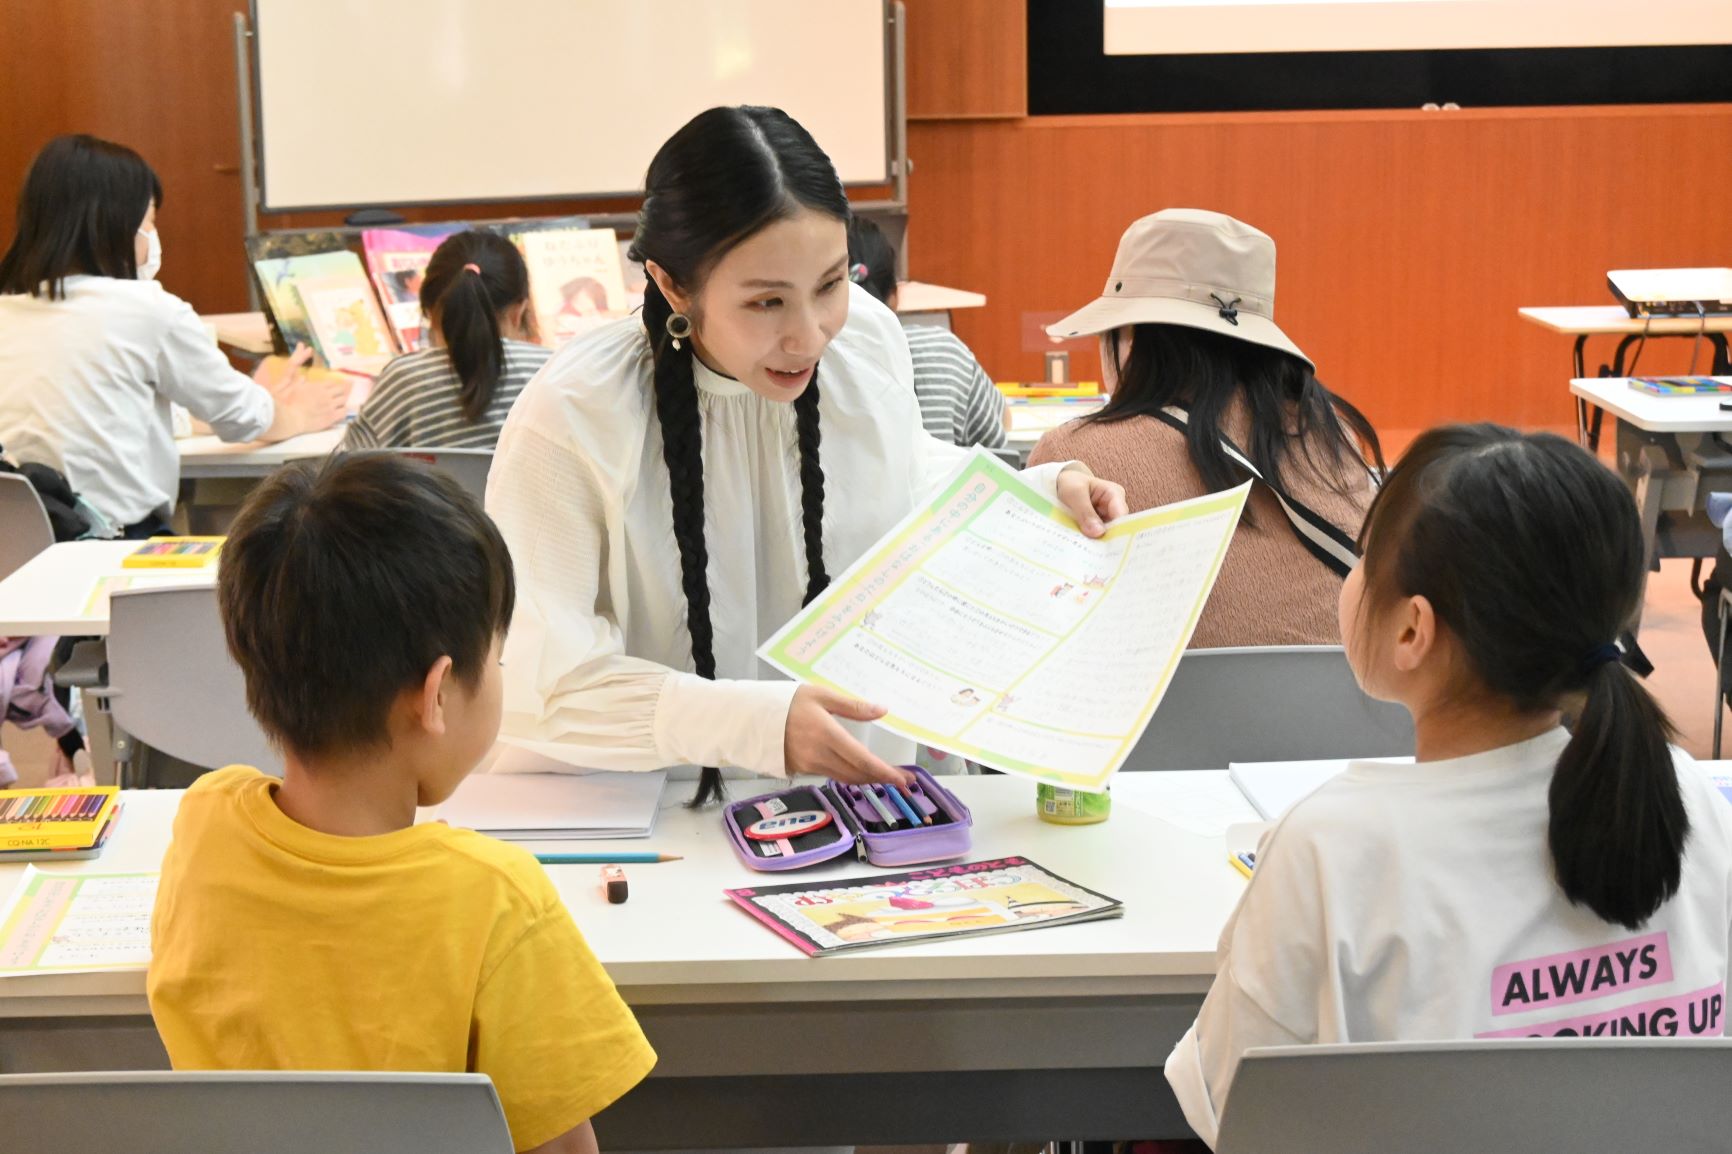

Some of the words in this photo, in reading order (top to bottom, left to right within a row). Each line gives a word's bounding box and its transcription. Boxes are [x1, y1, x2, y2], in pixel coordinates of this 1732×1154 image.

[907, 856, 1025, 880] こどものとも
[1502, 944, 1658, 1007] ALWAYS
[1688, 994, 1722, 1035] UP
